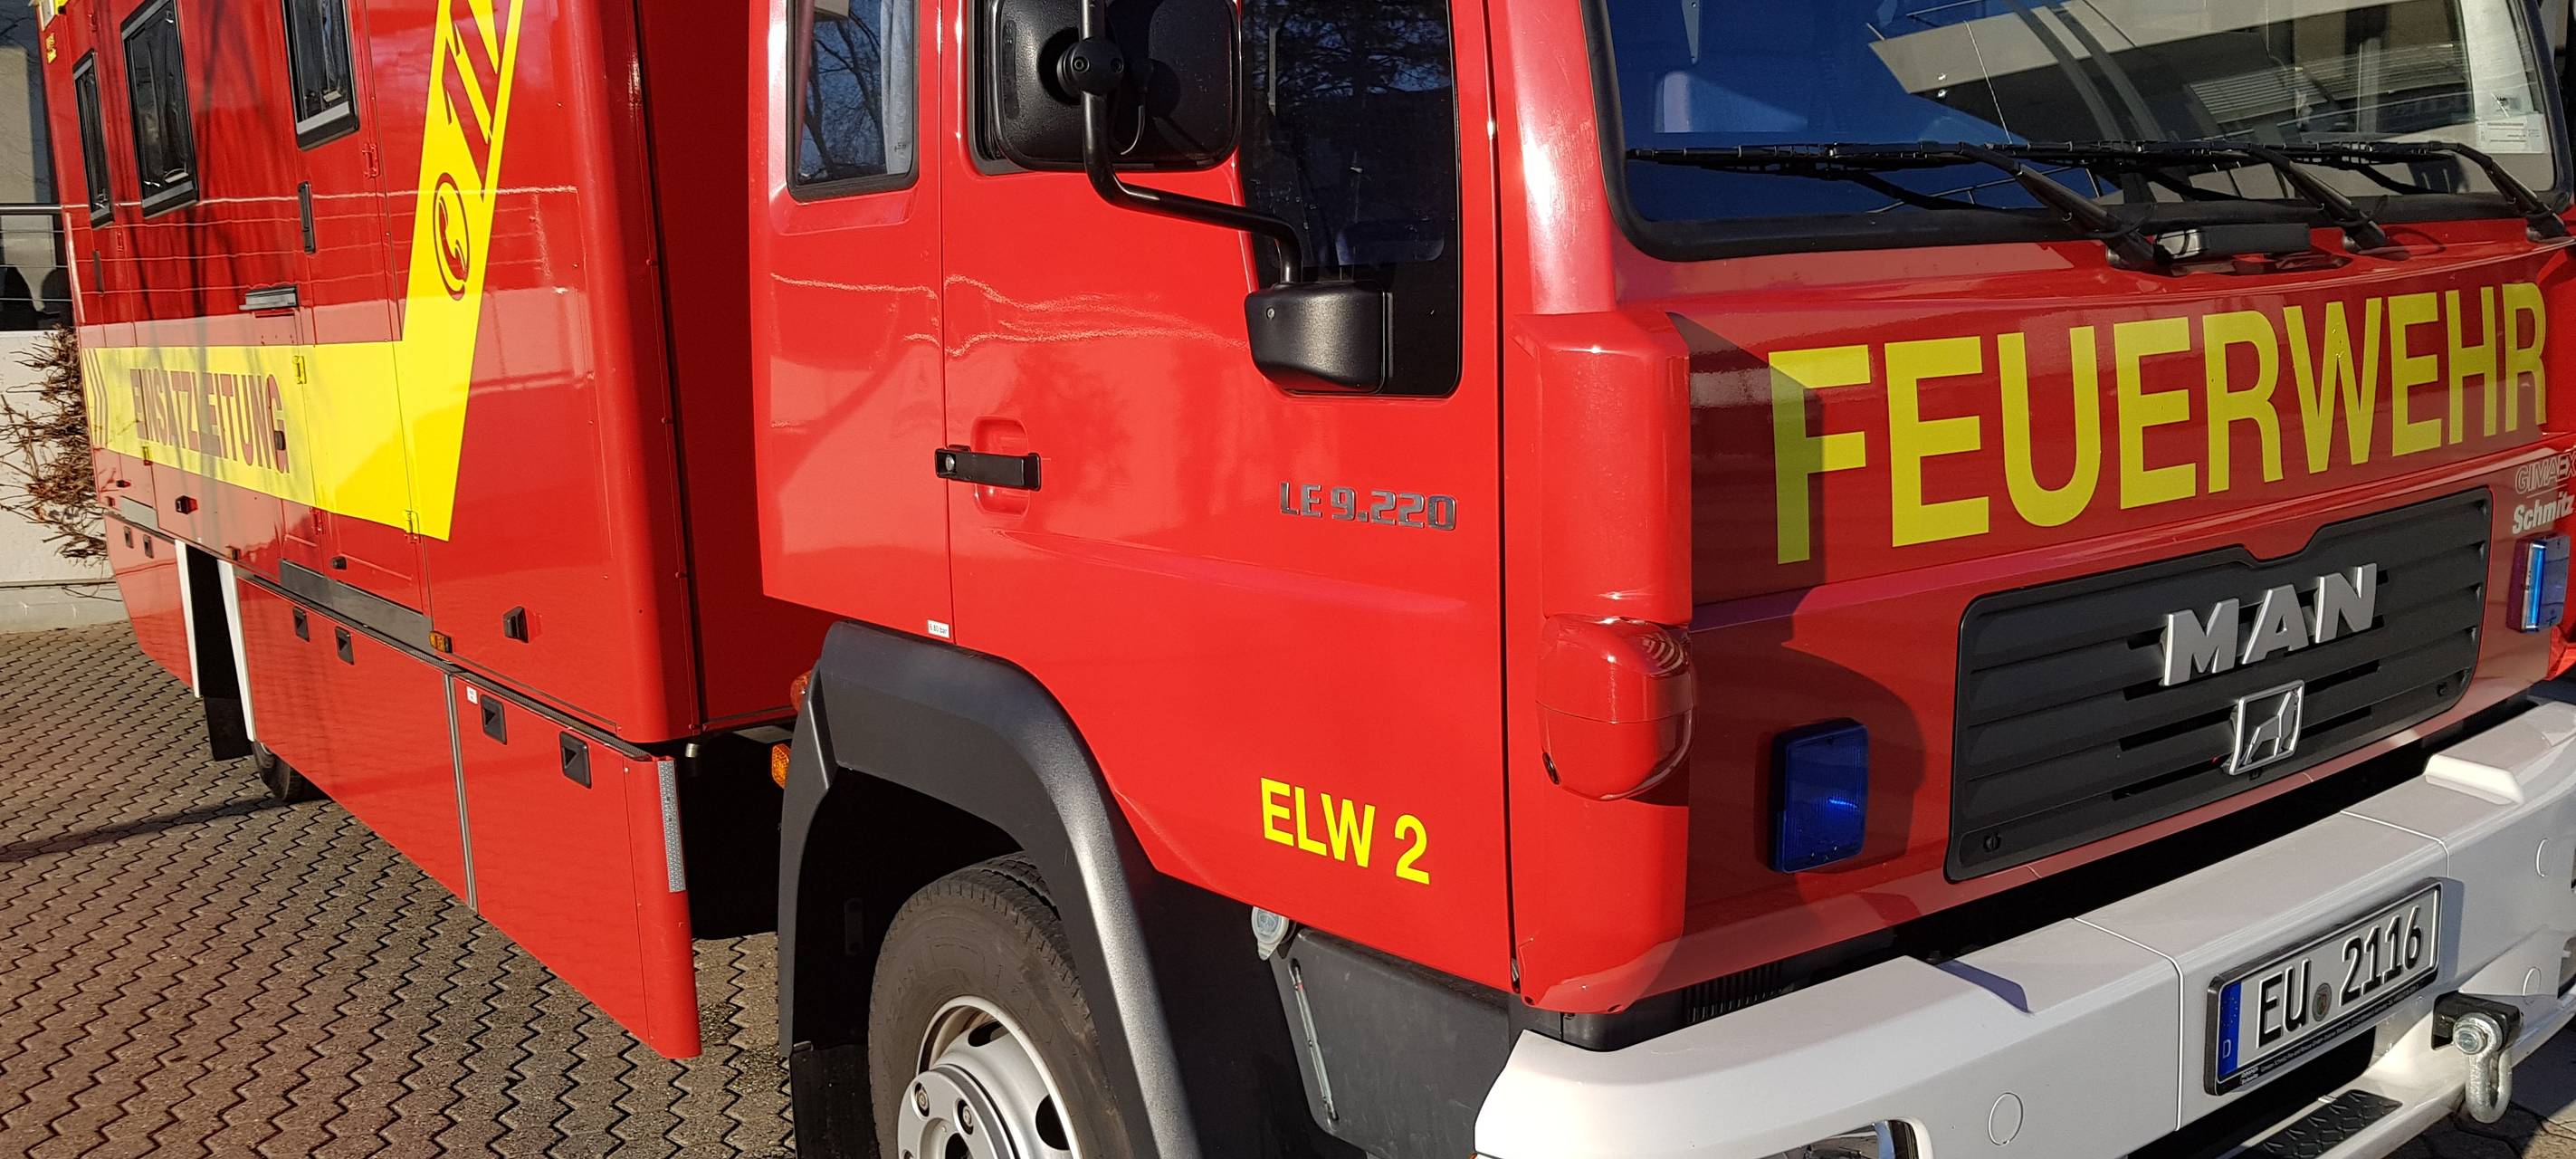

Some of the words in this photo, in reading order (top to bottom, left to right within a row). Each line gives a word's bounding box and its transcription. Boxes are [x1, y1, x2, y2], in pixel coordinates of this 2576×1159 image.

[129, 368, 291, 474] EINSATZLEITUNG
[1768, 281, 2547, 565] FEUERWEHR
[1280, 482, 1323, 518] LE
[1330, 486, 1457, 532] 9.220
[2512, 490, 2575, 534] Schmitz
[2161, 562, 2379, 686] MAN
[1261, 776, 1377, 868] ELW
[1394, 813, 1430, 885] 2
[2256, 957, 2312, 1049] EU
[2338, 905, 2423, 1008] 2116
